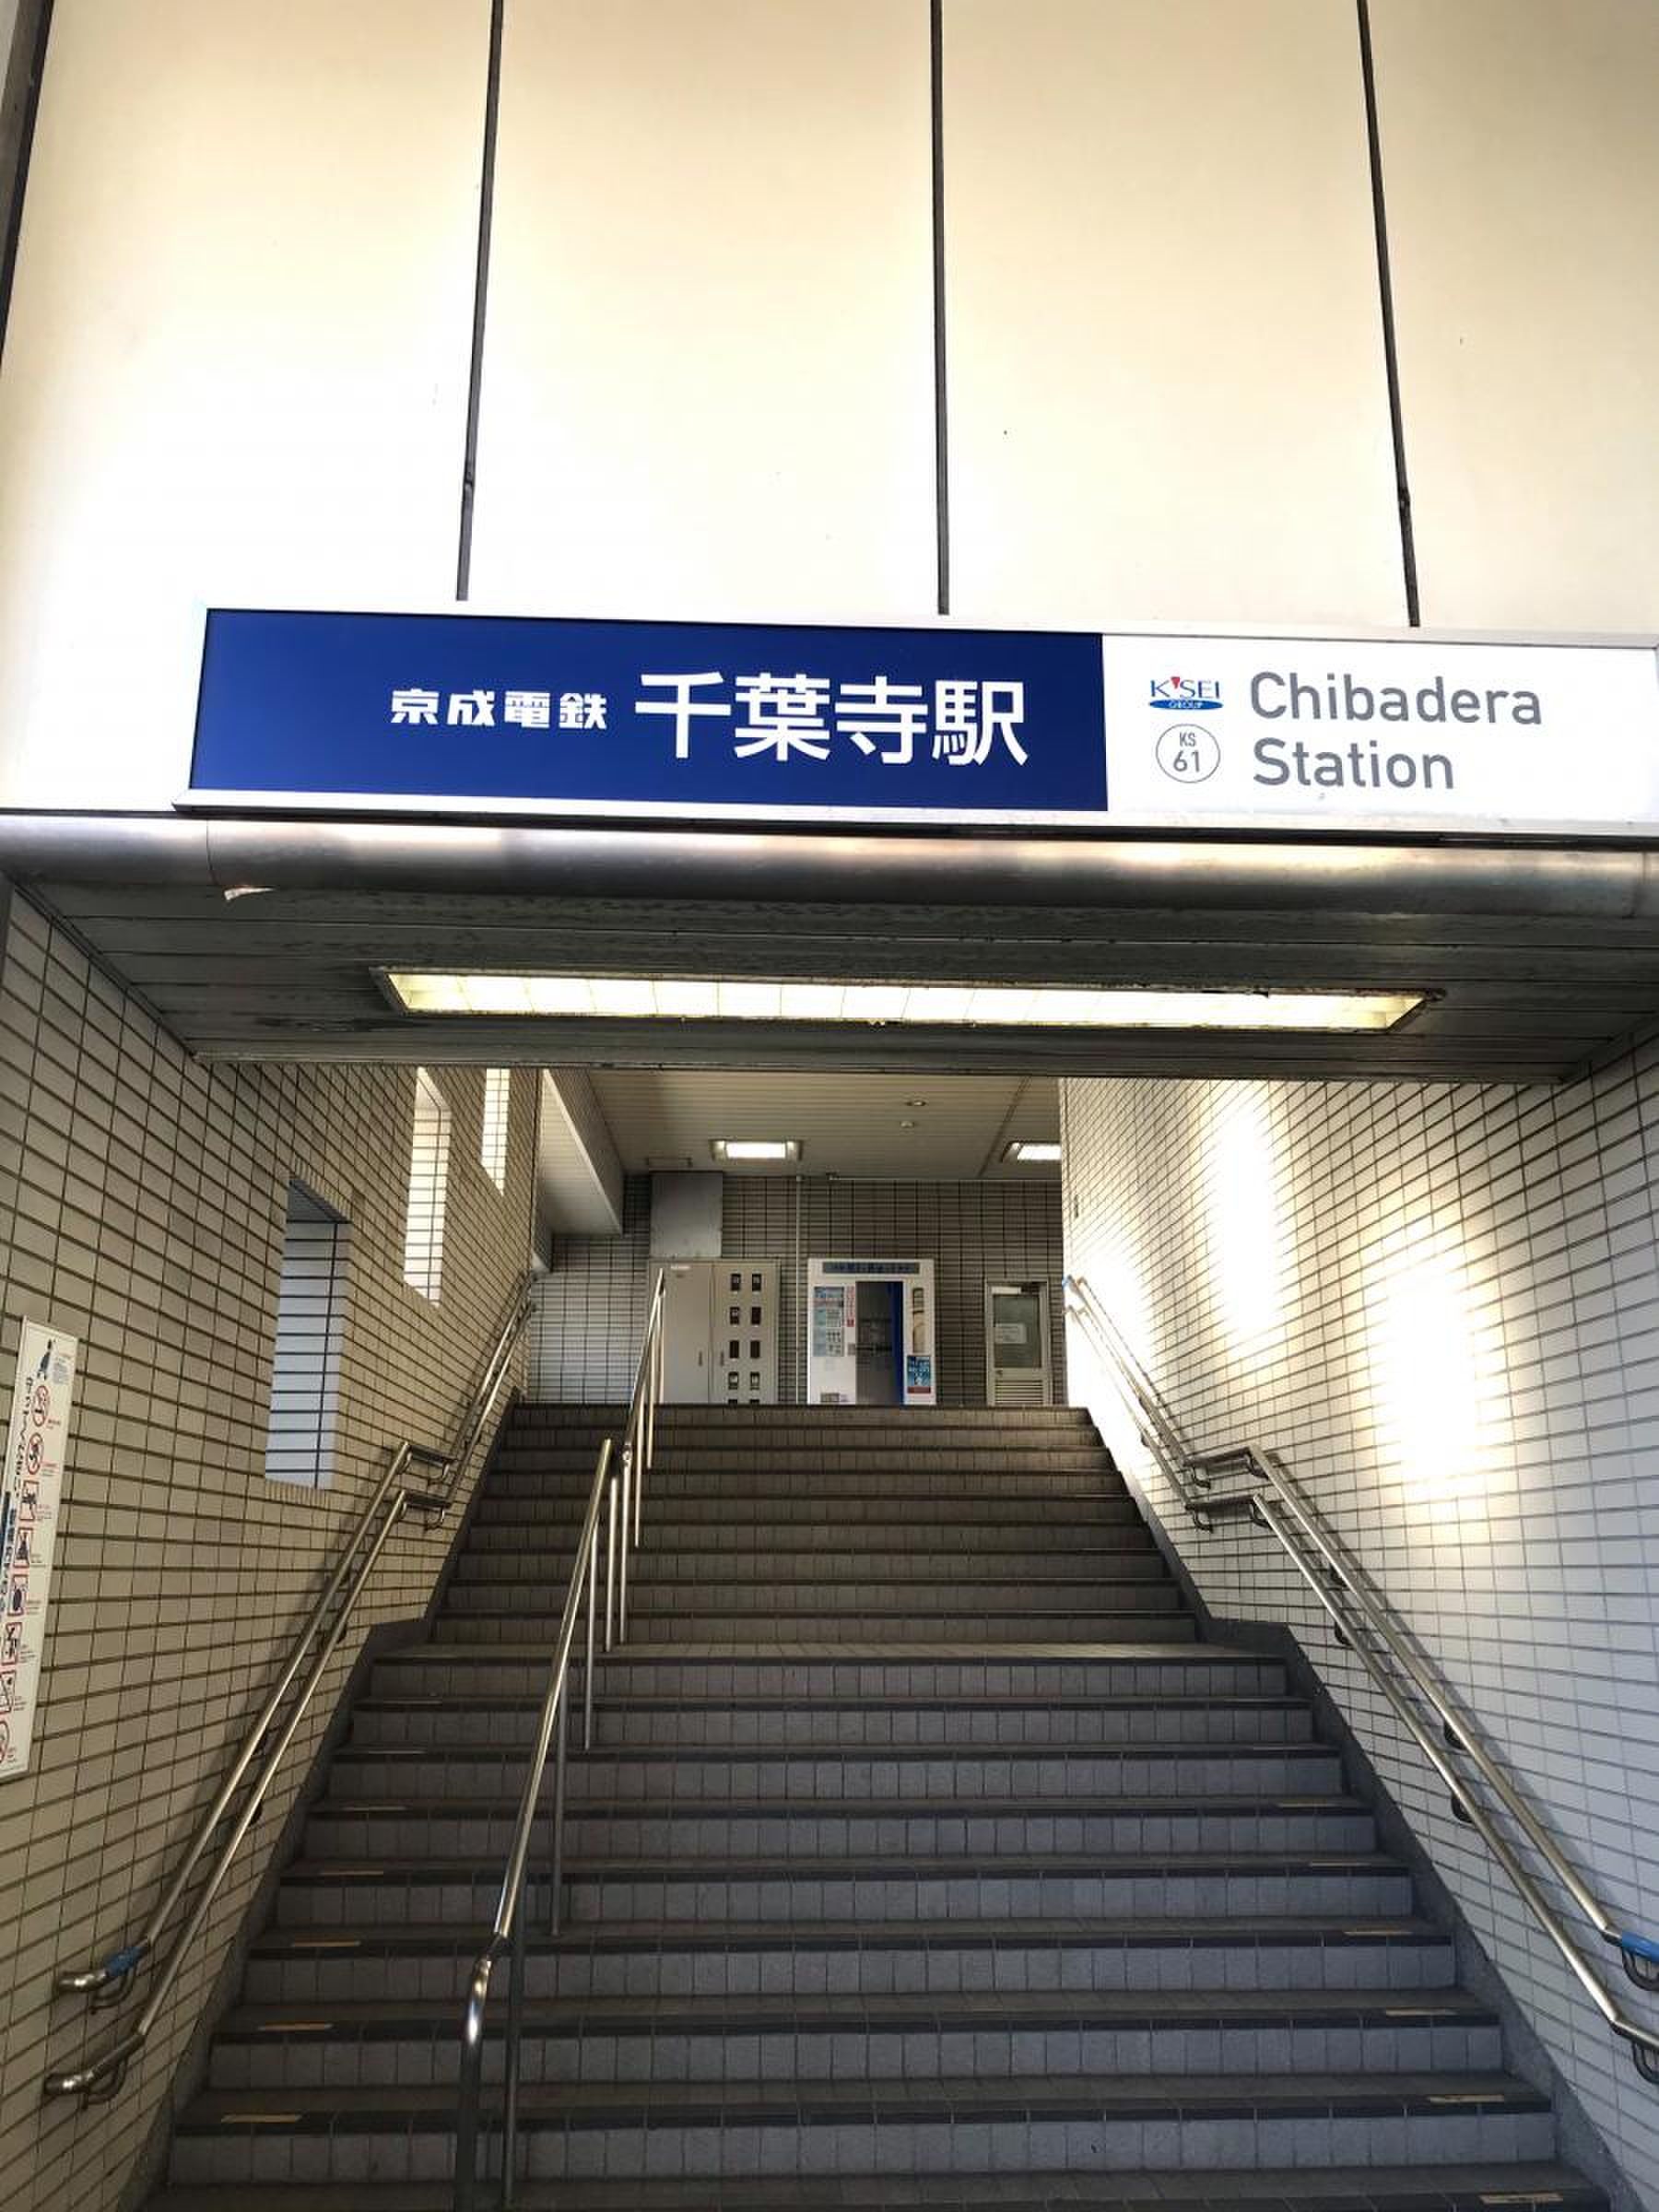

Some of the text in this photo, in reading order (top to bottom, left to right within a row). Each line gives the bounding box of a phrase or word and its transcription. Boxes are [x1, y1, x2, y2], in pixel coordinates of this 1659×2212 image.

[390, 671, 1030, 767] 京成電鉄 千葉寺駅
[1250, 671, 1543, 725] Chibadera
[1173, 749, 1200, 772] 61
[1179, 732, 1196, 747] KS
[1253, 736, 1454, 790] Station
